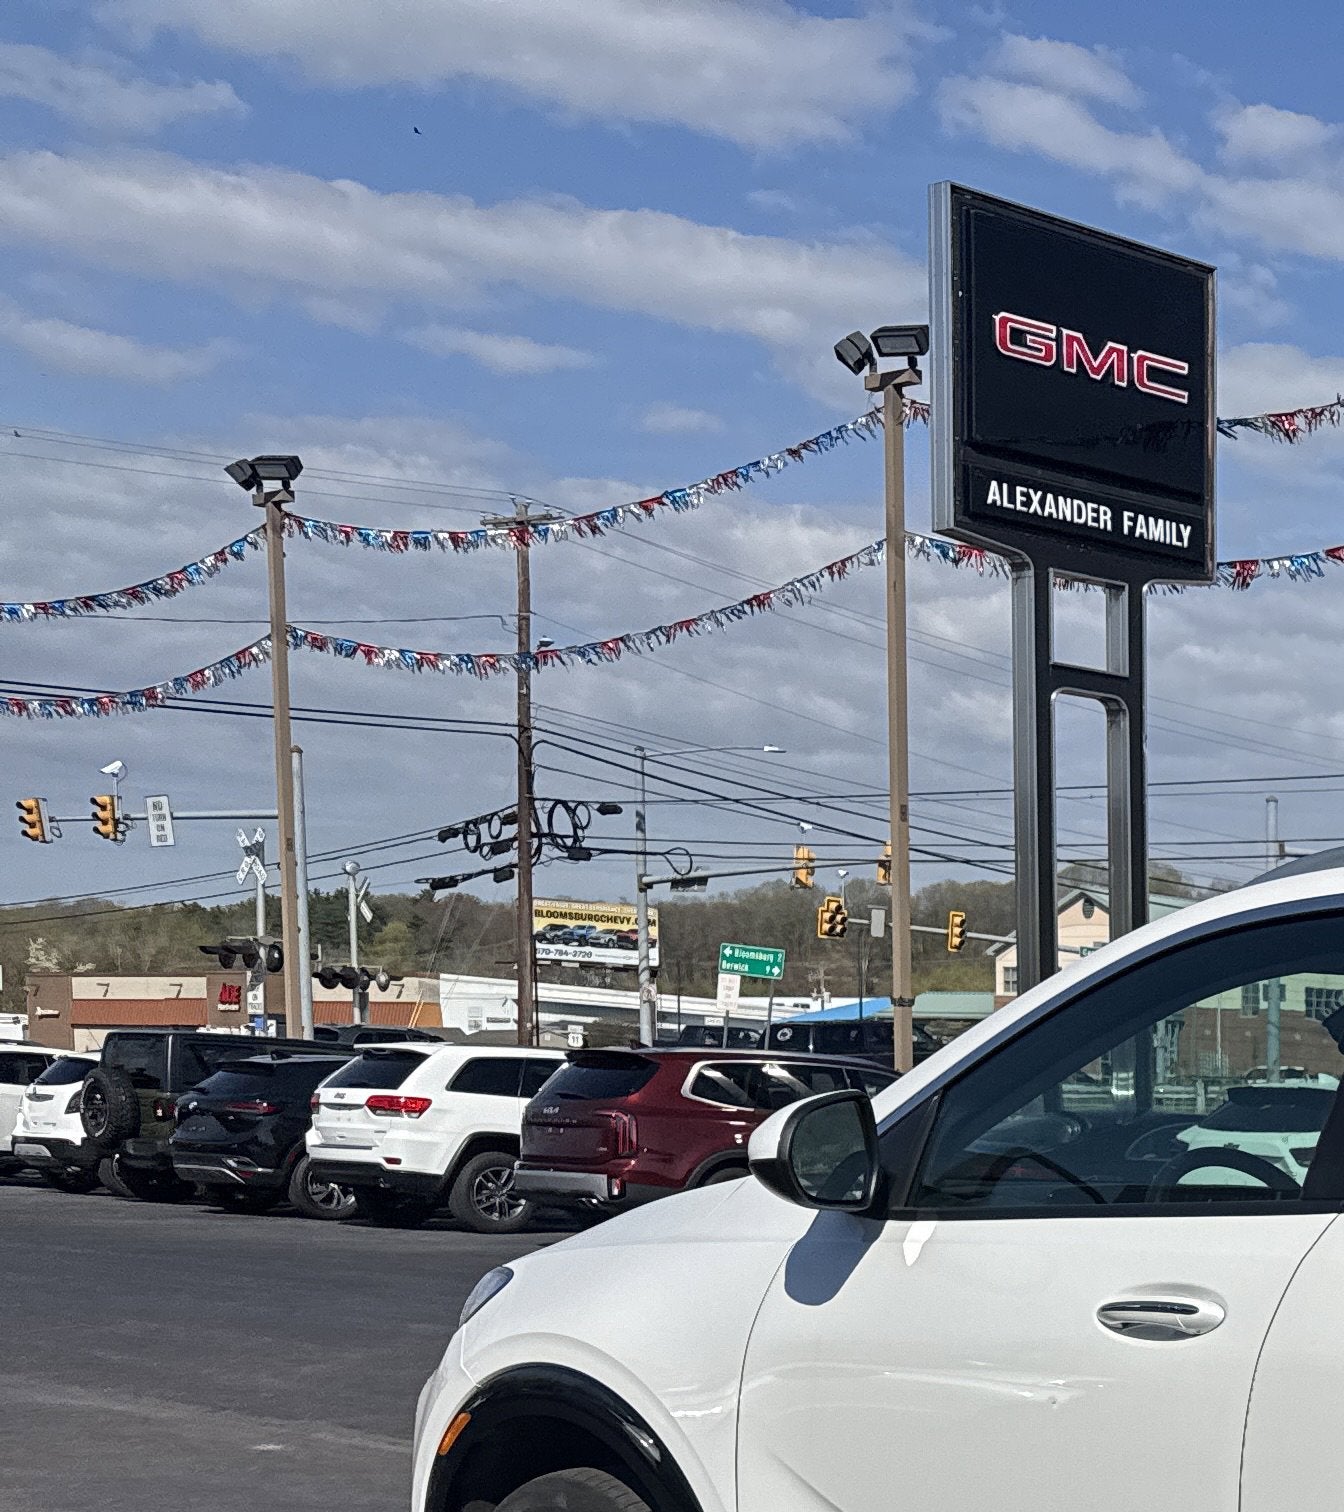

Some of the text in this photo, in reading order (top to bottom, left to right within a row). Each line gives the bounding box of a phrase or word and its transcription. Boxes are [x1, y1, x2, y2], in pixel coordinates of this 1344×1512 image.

[992, 311, 1189, 404] GMC
[986, 480, 1192, 549] ALEXANDER FAMILY
[534, 909, 657, 927] BLOOMSBURGCHEVY.CM
